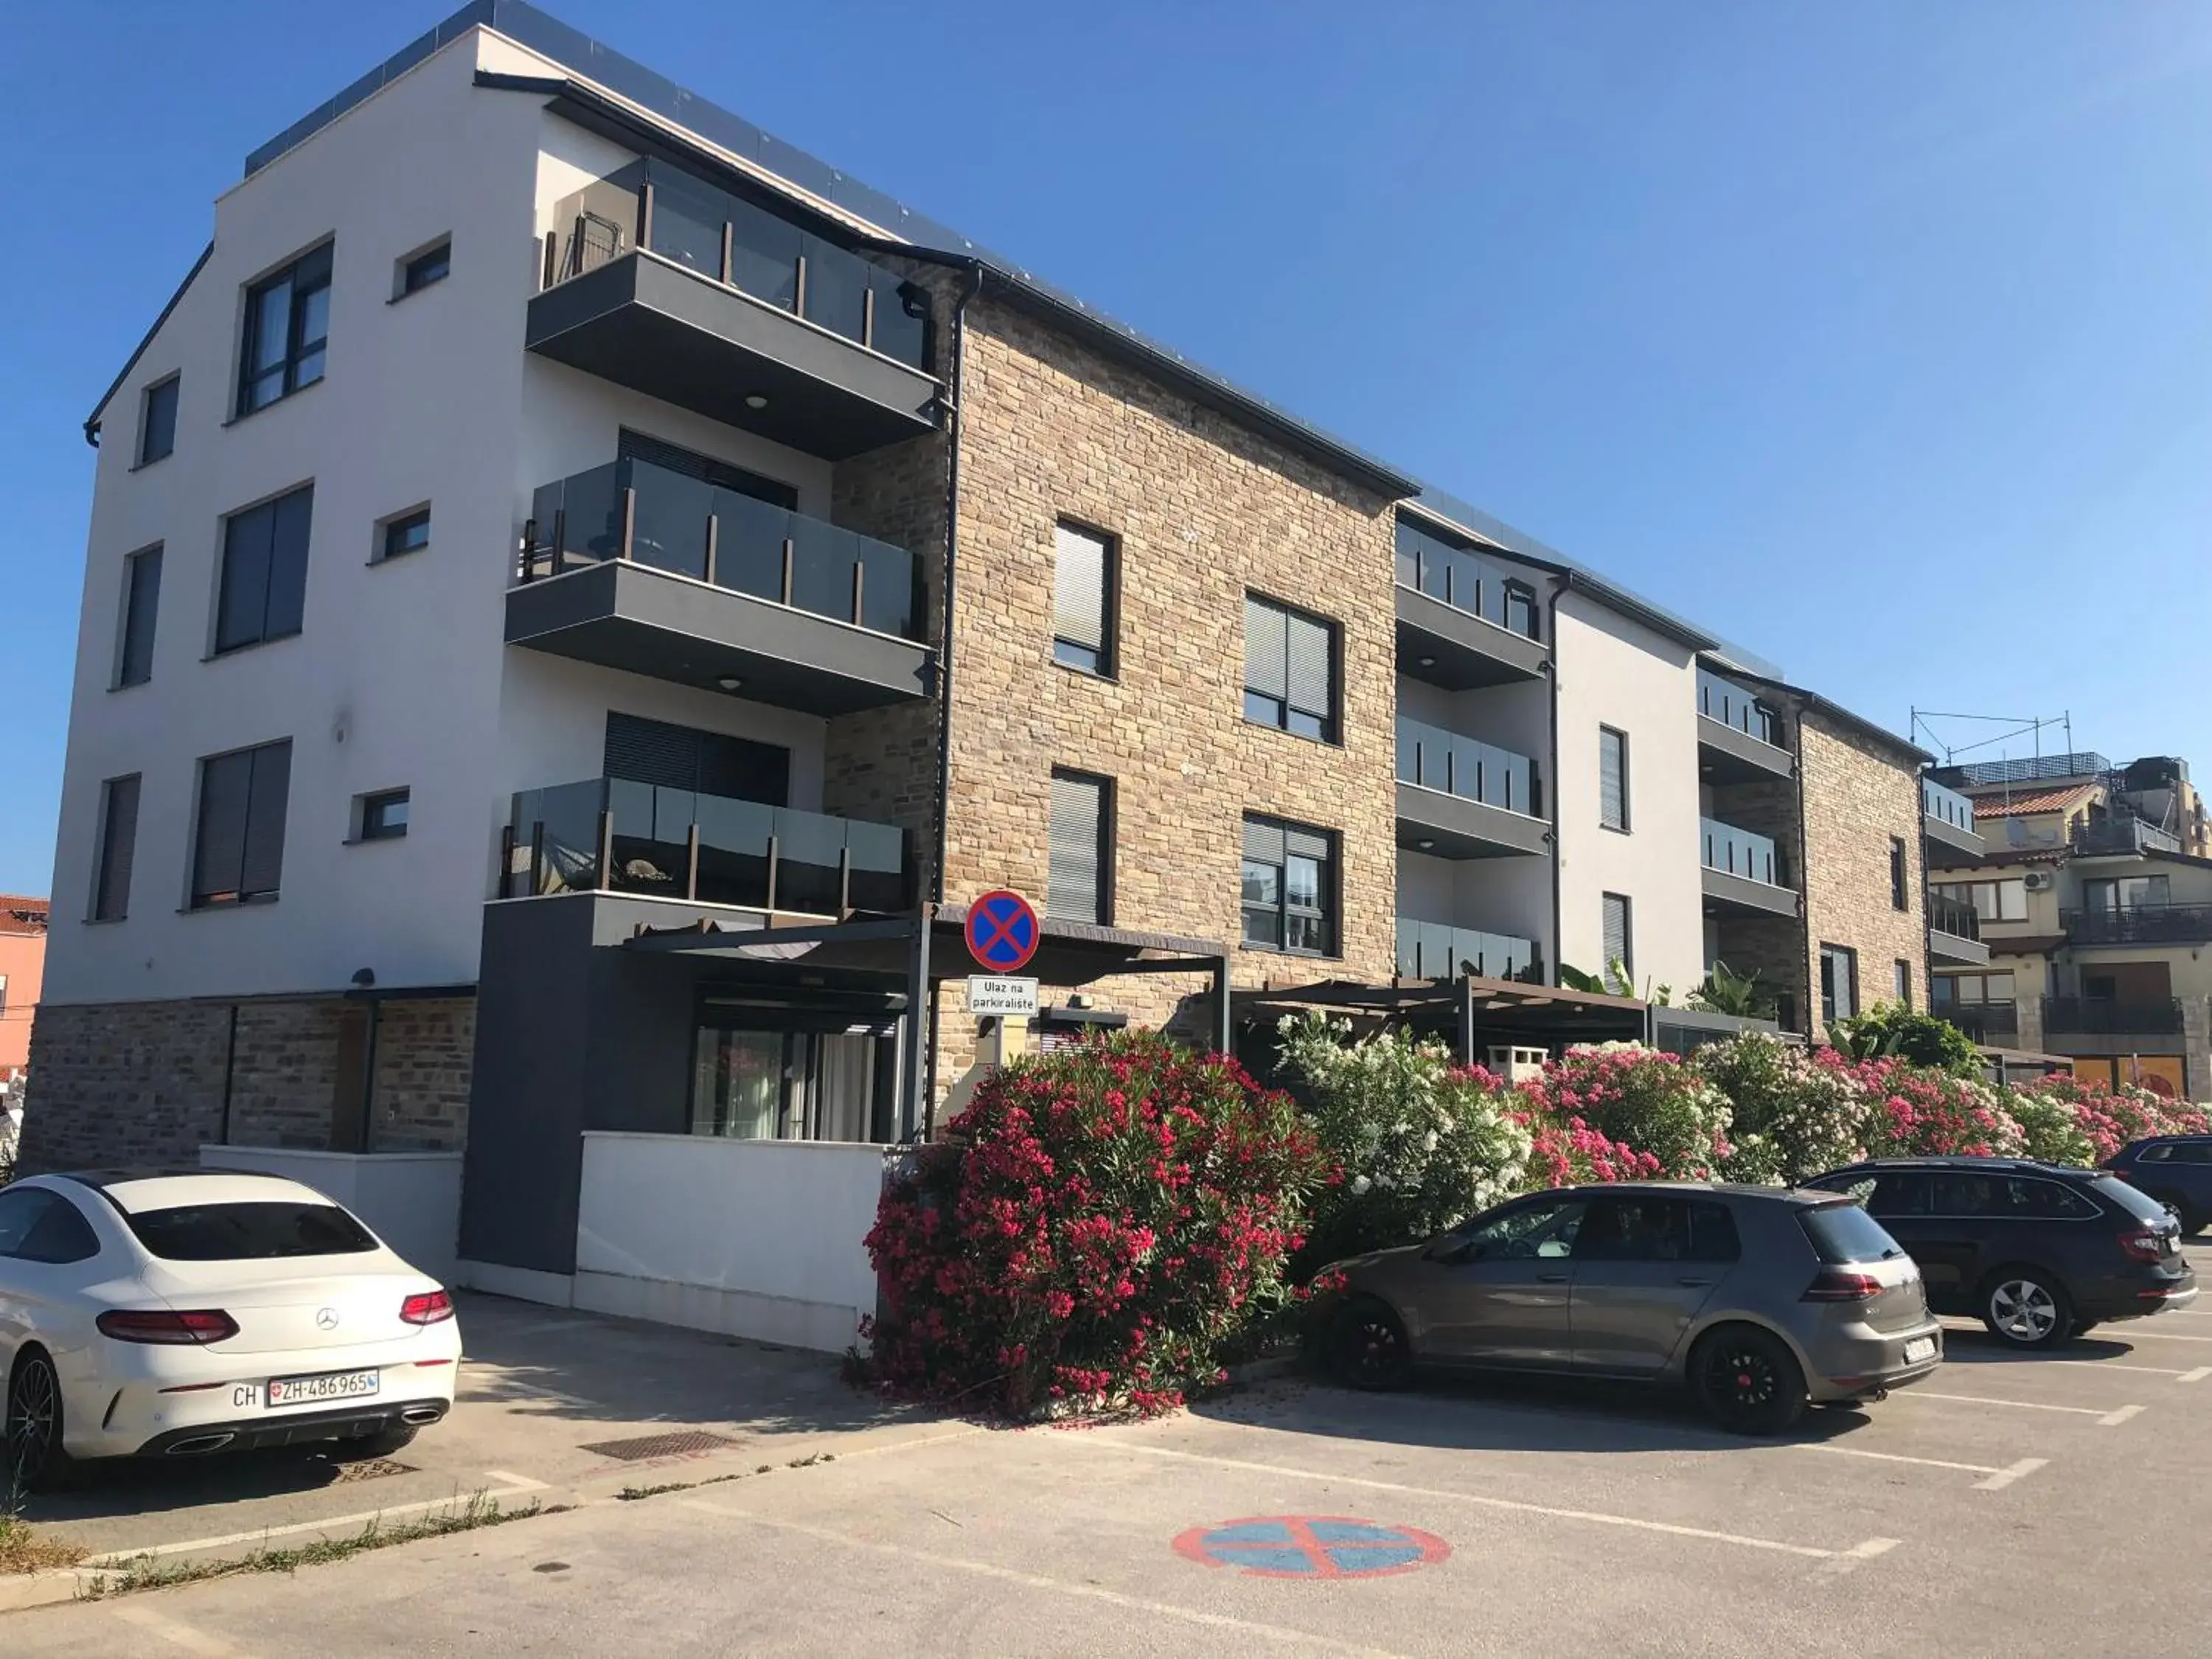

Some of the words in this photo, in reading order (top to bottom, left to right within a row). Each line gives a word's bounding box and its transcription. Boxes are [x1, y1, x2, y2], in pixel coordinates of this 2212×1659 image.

[984, 981, 1006, 992] Ulaz
[1011, 984, 1023, 993] na
[973, 998, 1033, 1010] parkiralište
[233, 1386, 256, 1406] CH
